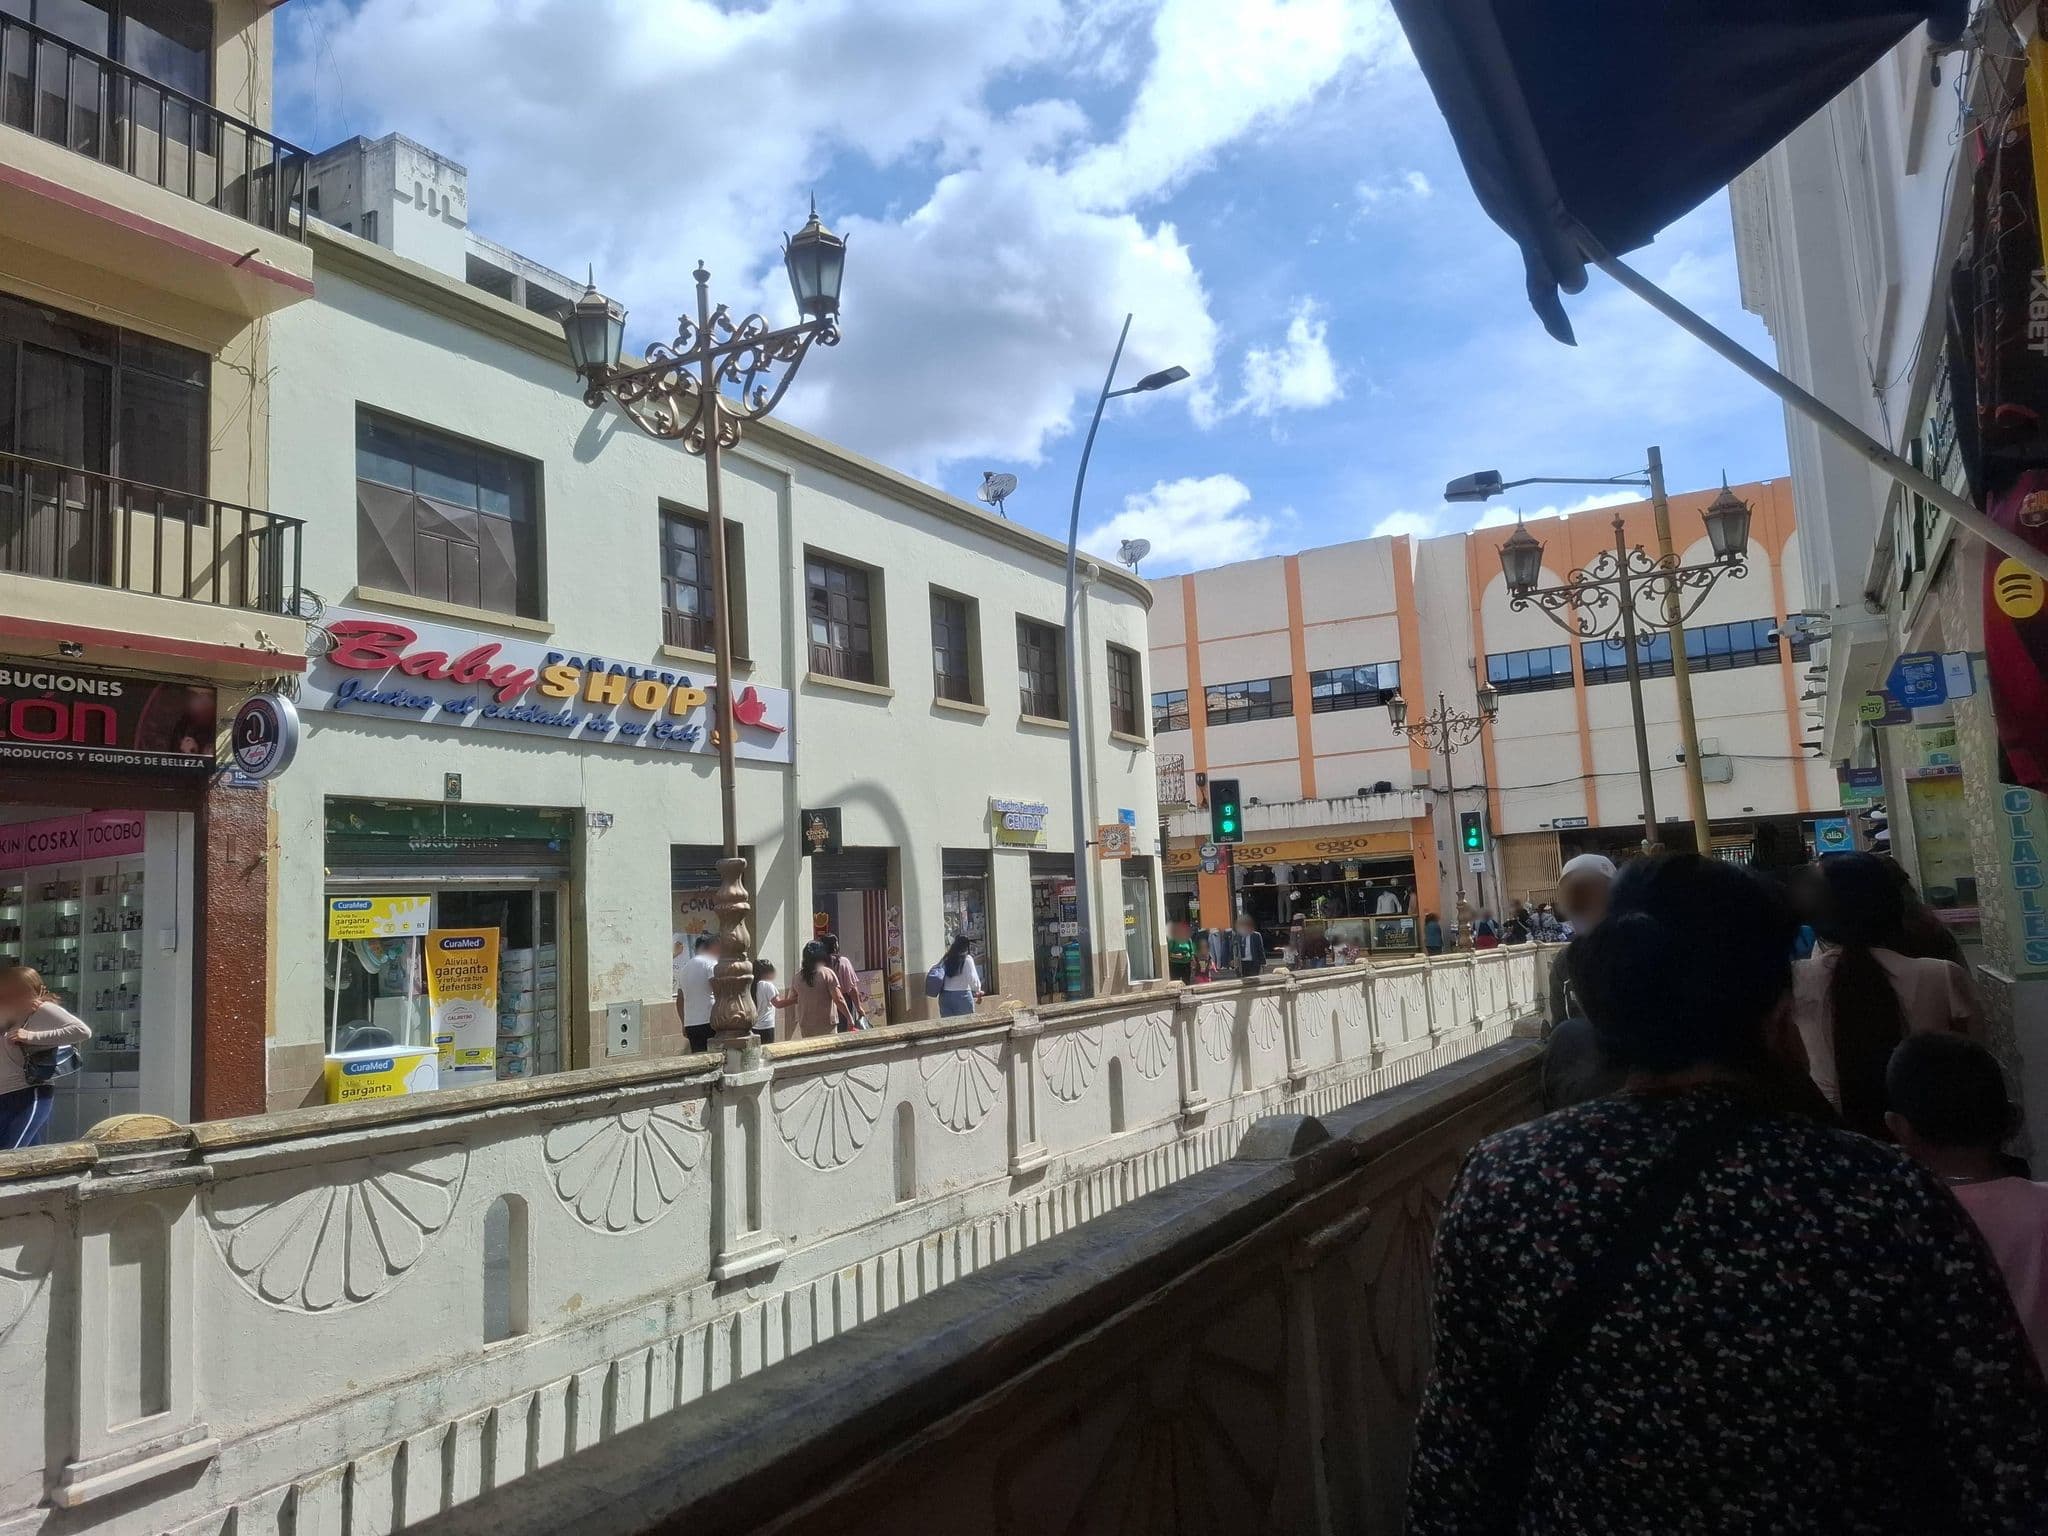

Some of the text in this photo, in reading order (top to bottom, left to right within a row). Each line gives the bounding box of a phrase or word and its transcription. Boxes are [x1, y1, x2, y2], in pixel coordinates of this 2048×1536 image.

[326, 620, 537, 703] Baby
[547, 652, 692, 687] PAÑALERA
[0, 670, 123, 697] BUCIONES
[540, 665, 707, 716] SHOP
[334, 677, 436, 709] Juntos
[443, 695, 477, 714] al
[482, 704, 581, 726] cuidado
[587, 714, 616, 732] de
[1861, 705, 1881, 714] Pay
[0, 690, 118, 745] ón
[77, 752, 86, 761] Y
[89, 753, 141, 765] EQUIPOS
[144, 757, 159, 767] DE
[161, 758, 205, 769] BELLEZA
[1225, 806, 1231, 816] 9
[1006, 813, 1041, 830] CENTRAL
[28, 829, 79, 853] COSRX
[87, 821, 142, 844] TOCOBO
[1315, 838, 1369, 854] eggo
[2003, 785, 2048, 965] CLABLES
[335, 918, 370, 926] garganta
[444, 939, 480, 948] CuraMed
[445, 957, 479, 966] Alivia tu
[435, 965, 489, 979] garganta
[439, 983, 482, 992] defensas
[350, 1061, 388, 1072] CuraMed
[341, 1084, 392, 1099] garganta
